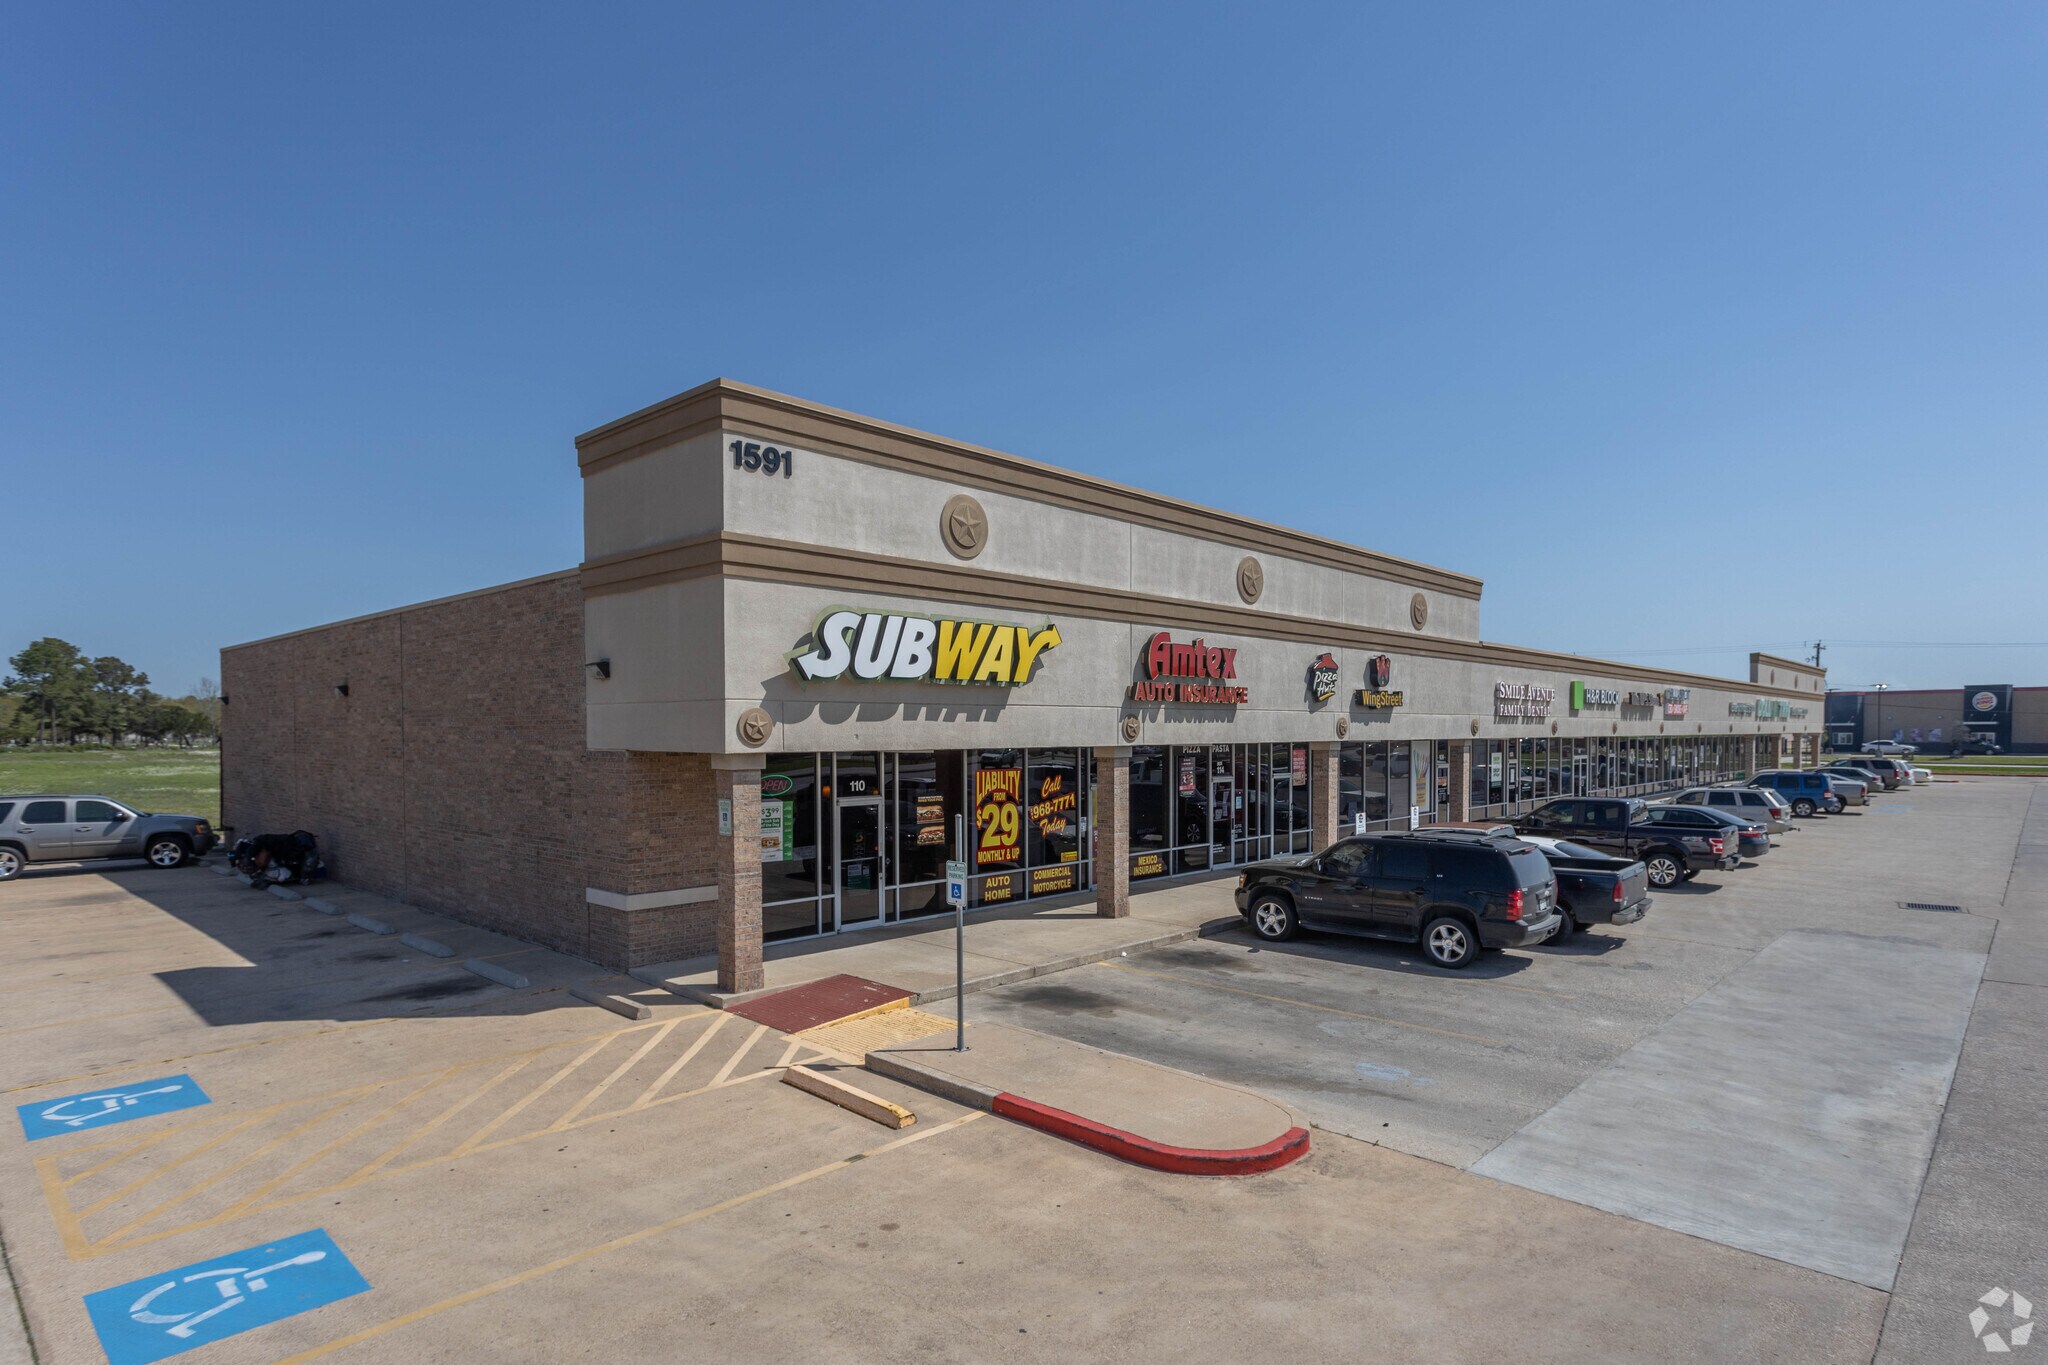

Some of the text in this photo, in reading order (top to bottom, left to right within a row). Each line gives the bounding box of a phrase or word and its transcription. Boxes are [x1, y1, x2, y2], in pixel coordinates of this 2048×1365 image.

[730, 440, 792, 476] 1591
[797, 610, 1062, 683] SUBWAY
[1148, 631, 1238, 680] Amtex
[1313, 671, 1338, 690] Pizza
[1317, 680, 1335, 698] Hut
[1134, 681, 1248, 704] AUTO INSURANCE
[1361, 690, 1403, 708] WingStreet
[1500, 681, 1556, 702] SMILE AVENUE
[1586, 689, 1600, 704] H&R
[1601, 690, 1619, 705] BLOCK
[1500, 704, 1551, 717] FAMILY DENTAL
[1182, 744, 1230, 754] PIZZA PASTA
[850, 780, 866, 792] 110
[976, 770, 1020, 806] LIABILITY
[1041, 774, 1062, 798] Call
[993, 792, 1006, 801] FROM
[1033, 793, 1076, 820] 968-7771
[1040, 817, 1067, 837] Today
[977, 847, 1020, 863] MONTHLY & UP
[1138, 854, 1158, 866] MEXICO
[1033, 866, 1072, 880] COMMERCIAL
[1133, 863, 1163, 877] INSURANCE
[986, 875, 1011, 888] AUTO
[1033, 878, 1072, 894] MOTORCYCLE
[984, 888, 1011, 901] HOME
